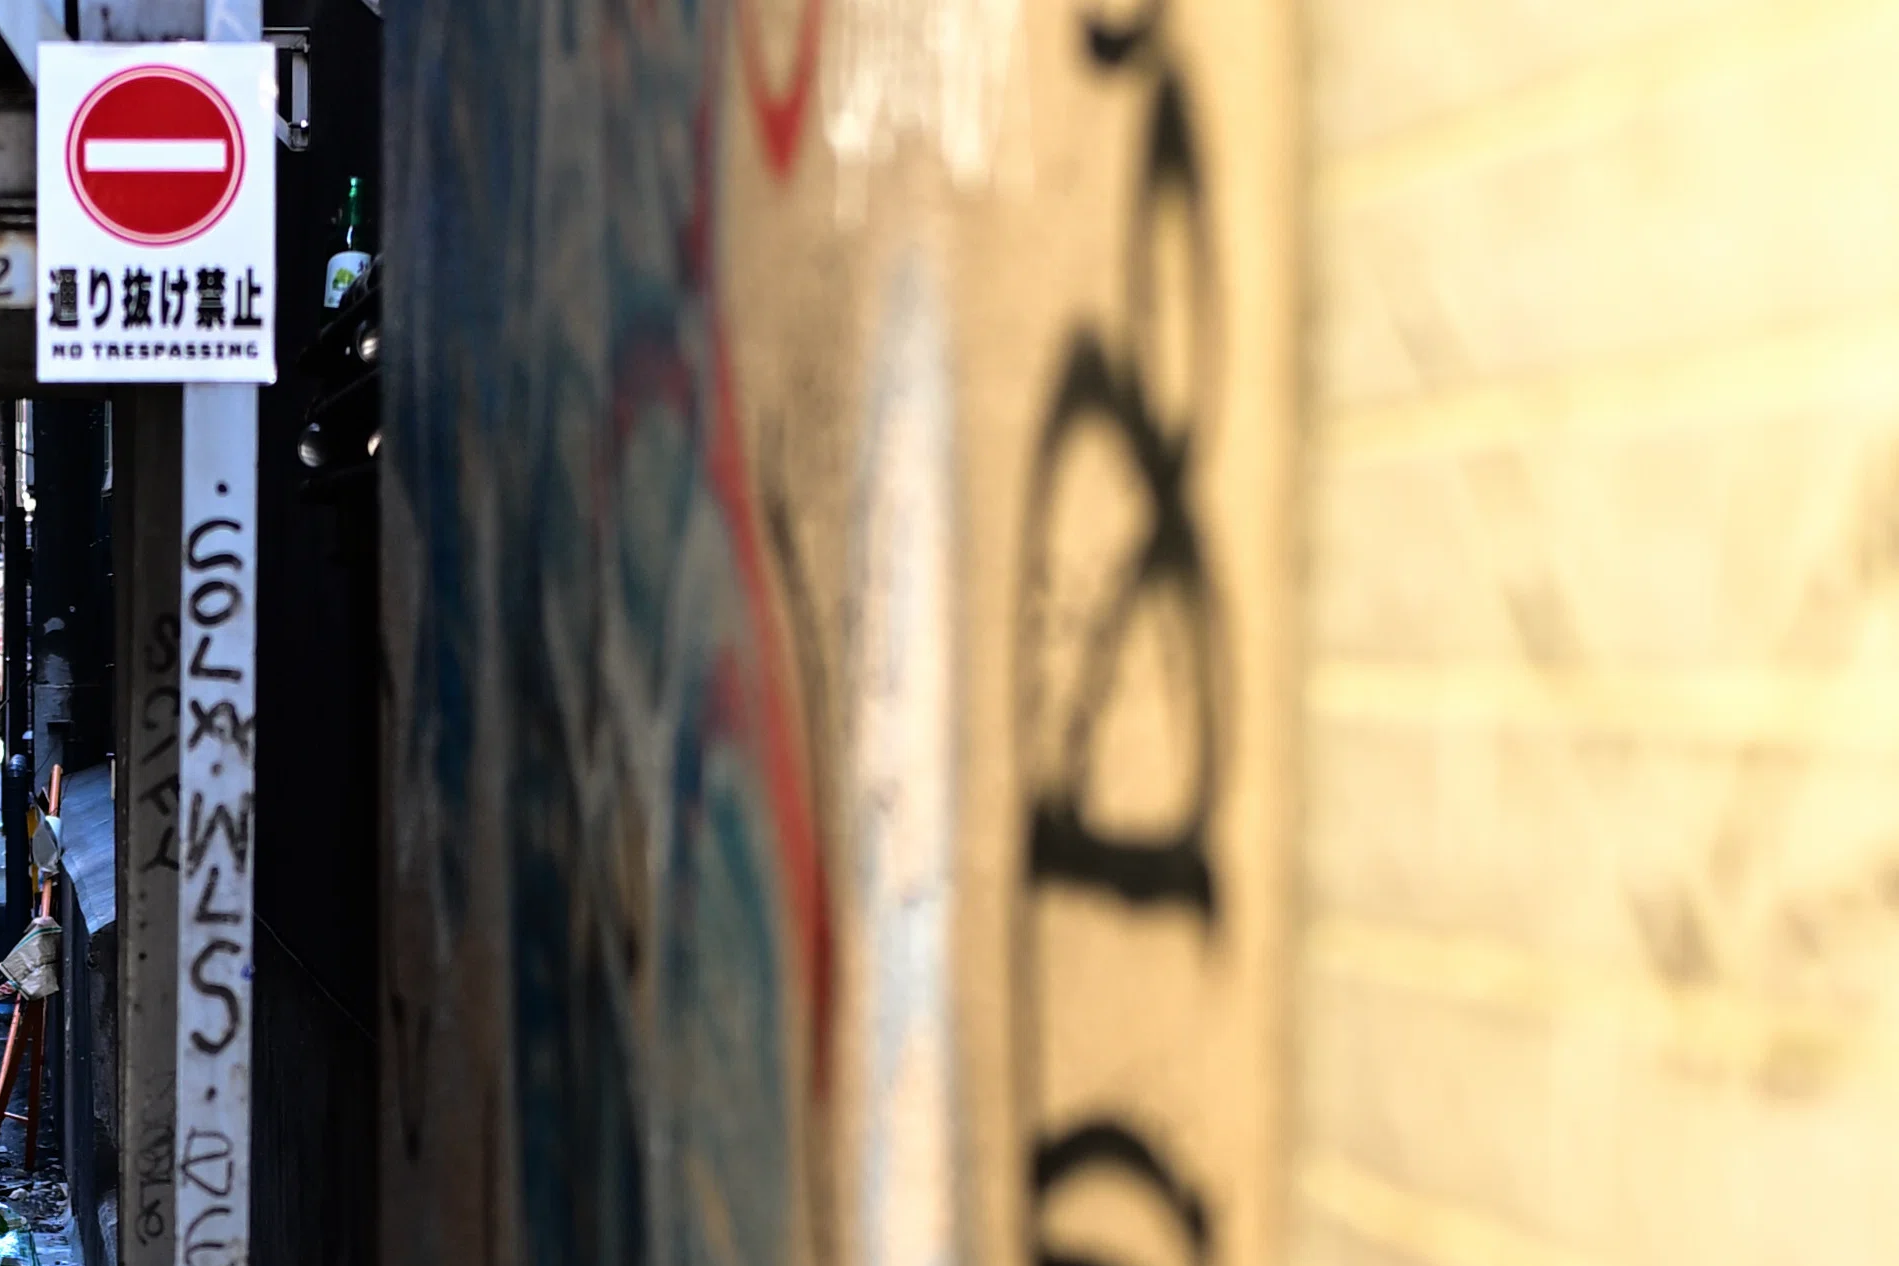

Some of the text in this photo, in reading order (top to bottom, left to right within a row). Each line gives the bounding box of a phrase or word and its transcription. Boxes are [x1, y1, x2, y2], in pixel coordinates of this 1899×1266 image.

[48, 266, 263, 329] 通り抜け禁止
[52, 341, 259, 360] NO TRESPASSING
